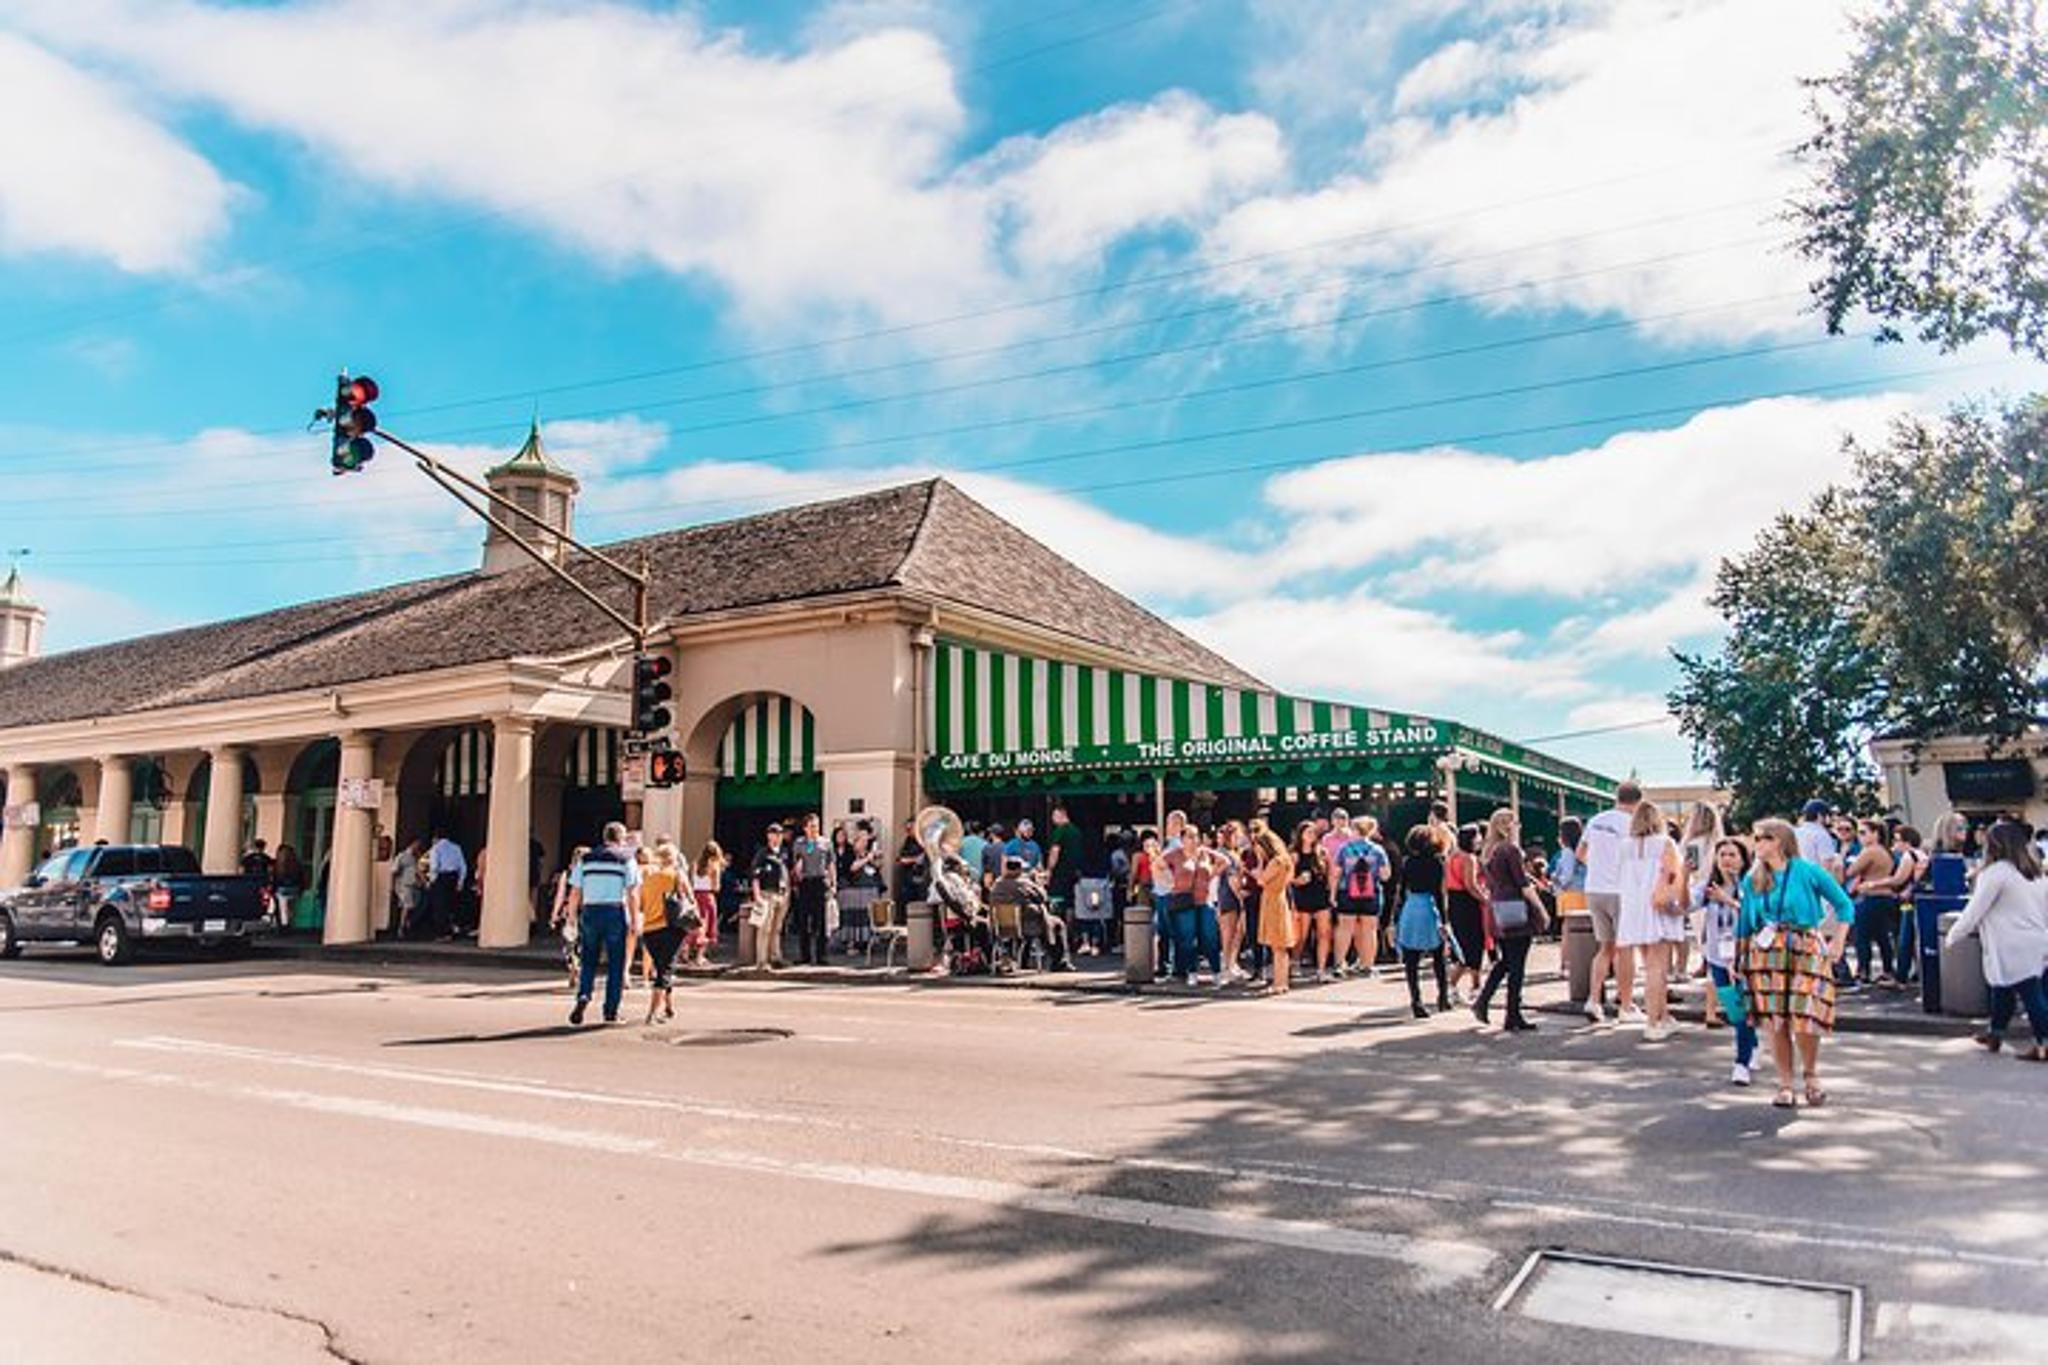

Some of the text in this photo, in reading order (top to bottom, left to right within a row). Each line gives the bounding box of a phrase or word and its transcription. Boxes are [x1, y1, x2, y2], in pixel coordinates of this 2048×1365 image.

[988, 752, 1011, 767] DU
[1014, 749, 1074, 766] MONDE
[1138, 741, 1176, 758] THE
[1182, 736, 1274, 756] ORIGINAL
[1280, 730, 1358, 751] COFFEE
[1366, 726, 1438, 746] STAND
